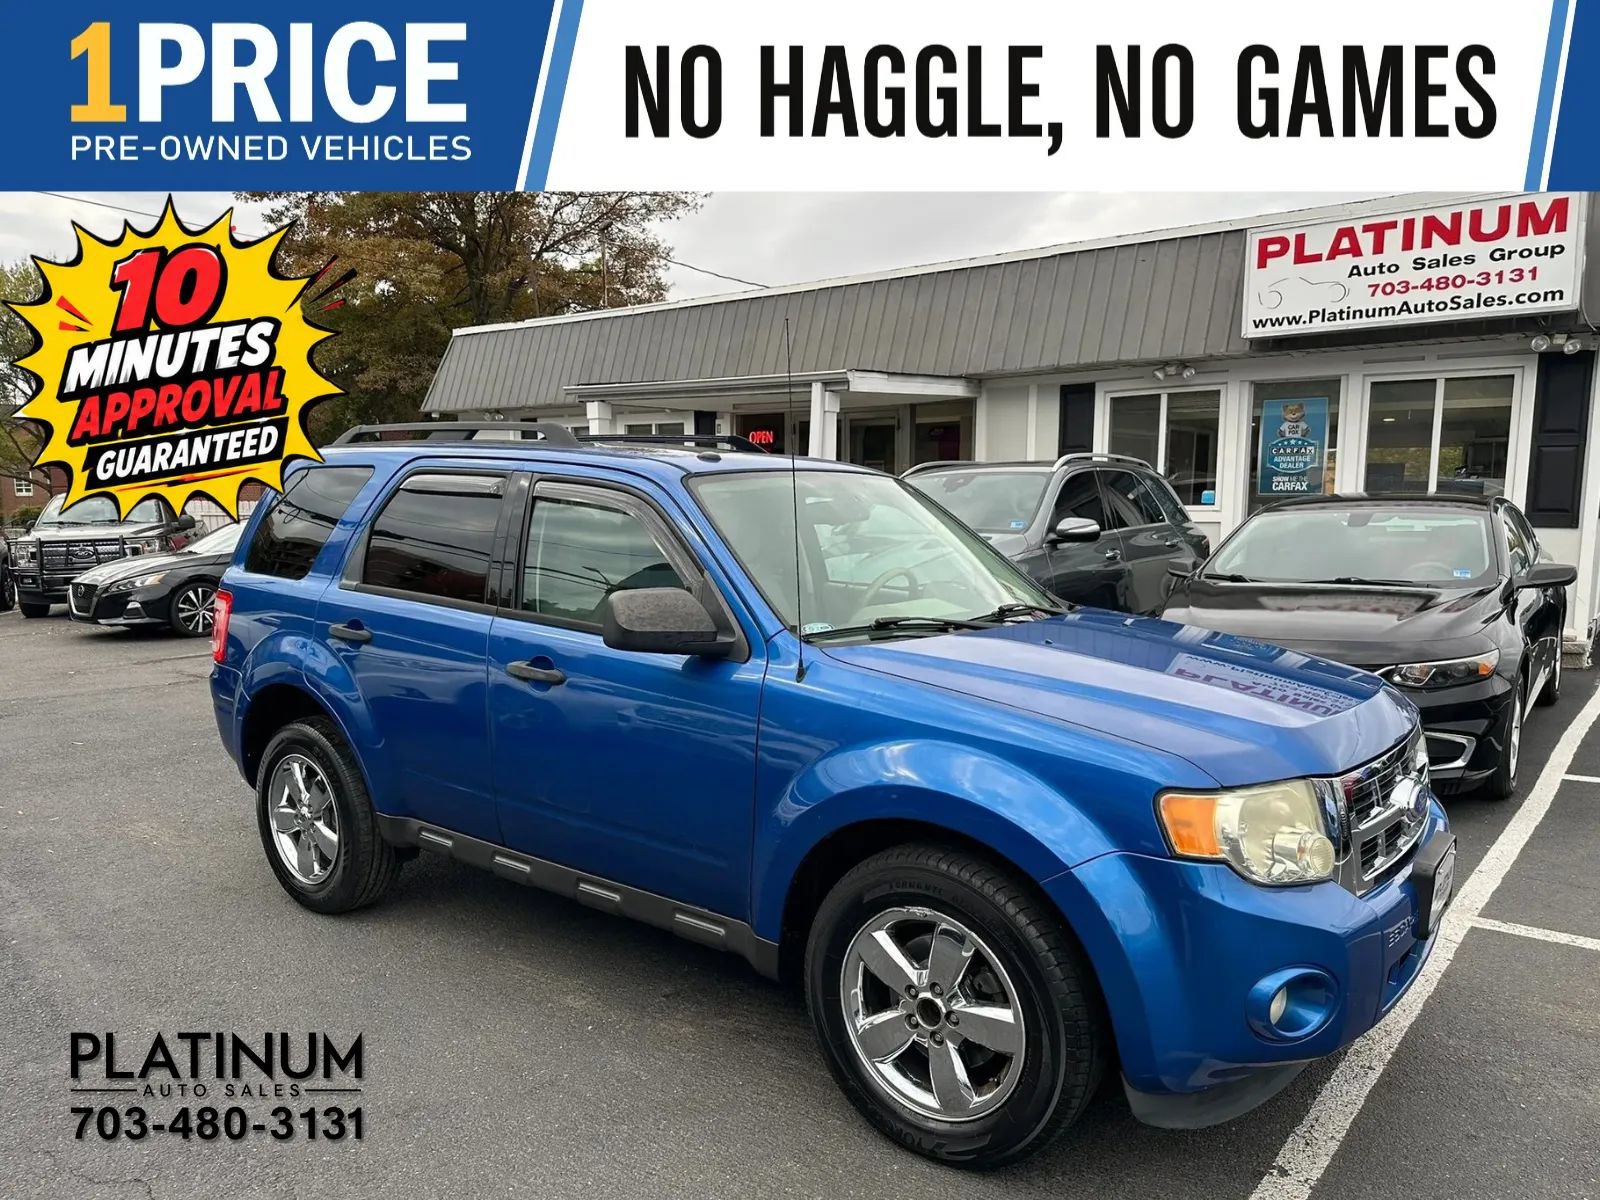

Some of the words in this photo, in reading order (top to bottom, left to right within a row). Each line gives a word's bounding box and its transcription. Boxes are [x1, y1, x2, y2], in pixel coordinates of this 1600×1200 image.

[1257, 197, 1569, 269] PLATINUM
[1347, 262, 1400, 279] Auto
[1412, 252, 1476, 272] Sales
[1489, 243, 1566, 263] Group
[1368, 266, 1538, 297] 703-480-3131
[1252, 288, 1565, 329] www.PlatinumAutoSales.com
[749, 431, 773, 444] OPEN
[1272, 446, 1315, 455] CARFAX
[1272, 481, 1309, 491] CARFAX
